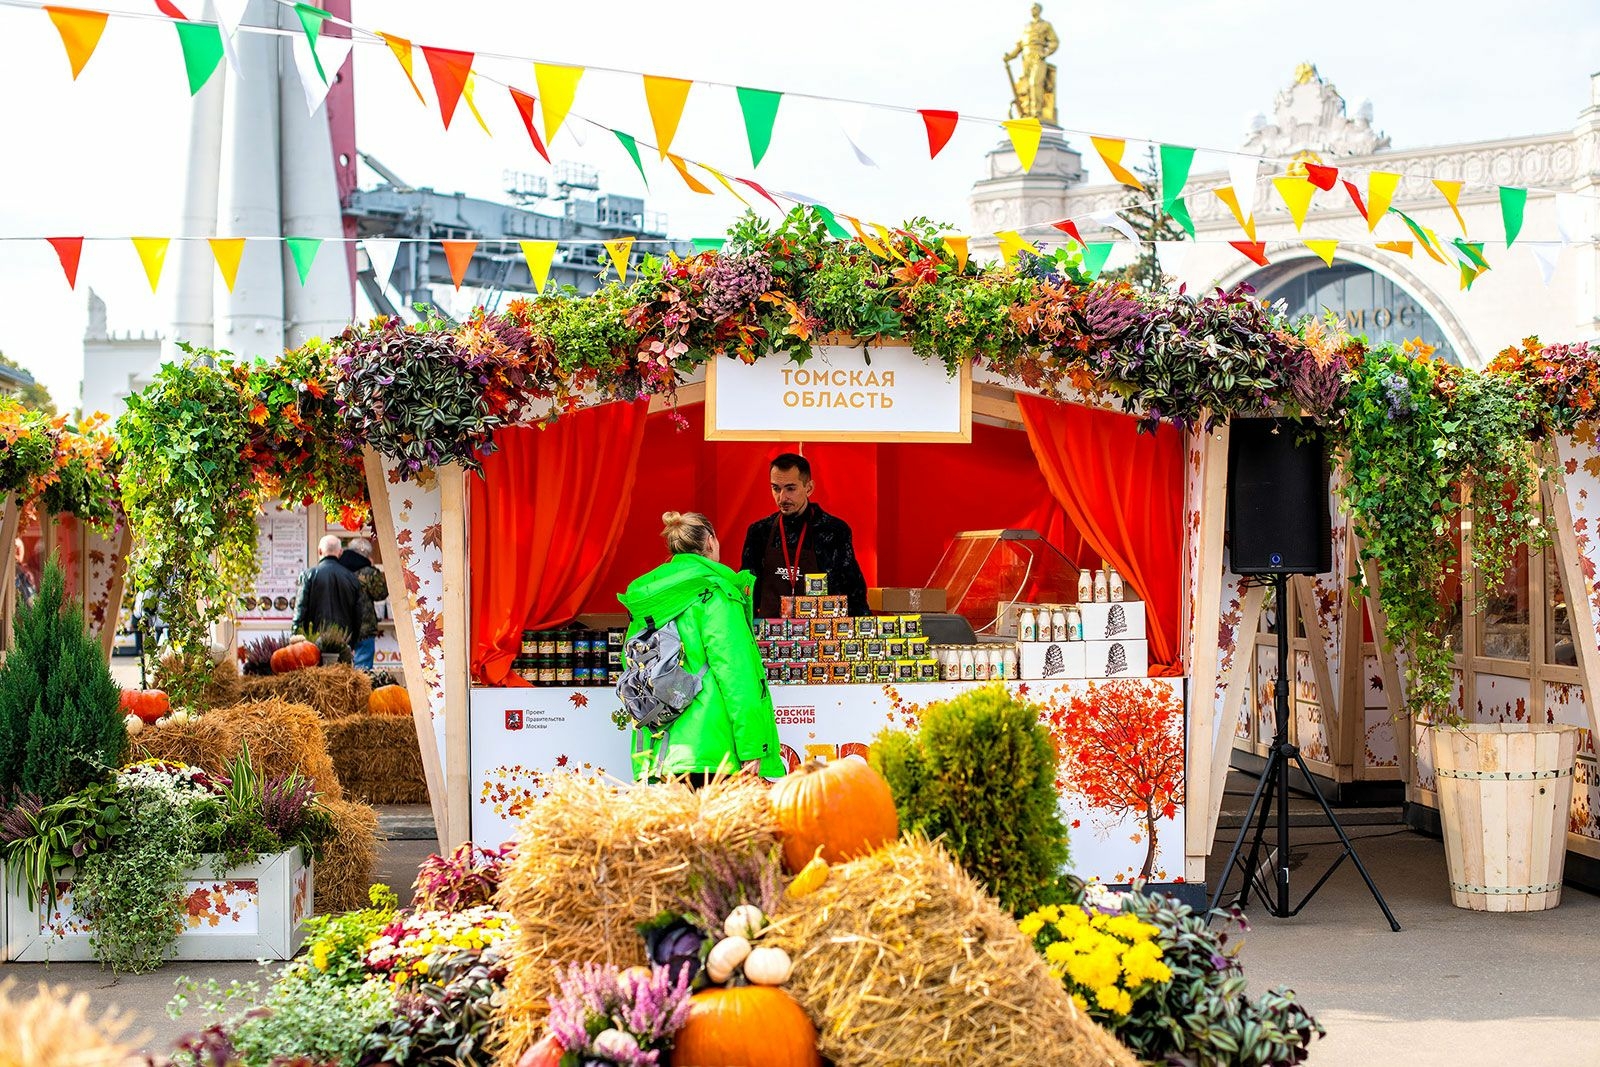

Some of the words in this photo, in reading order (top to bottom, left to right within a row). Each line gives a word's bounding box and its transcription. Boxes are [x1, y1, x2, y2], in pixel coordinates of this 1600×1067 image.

[1326, 305, 1416, 331] МОС
[781, 368, 895, 387] ТОМСКАЯ
[783, 390, 894, 409] ОБЛАСТЬ
[775, 717, 816, 725] СЕЗОНЫ
